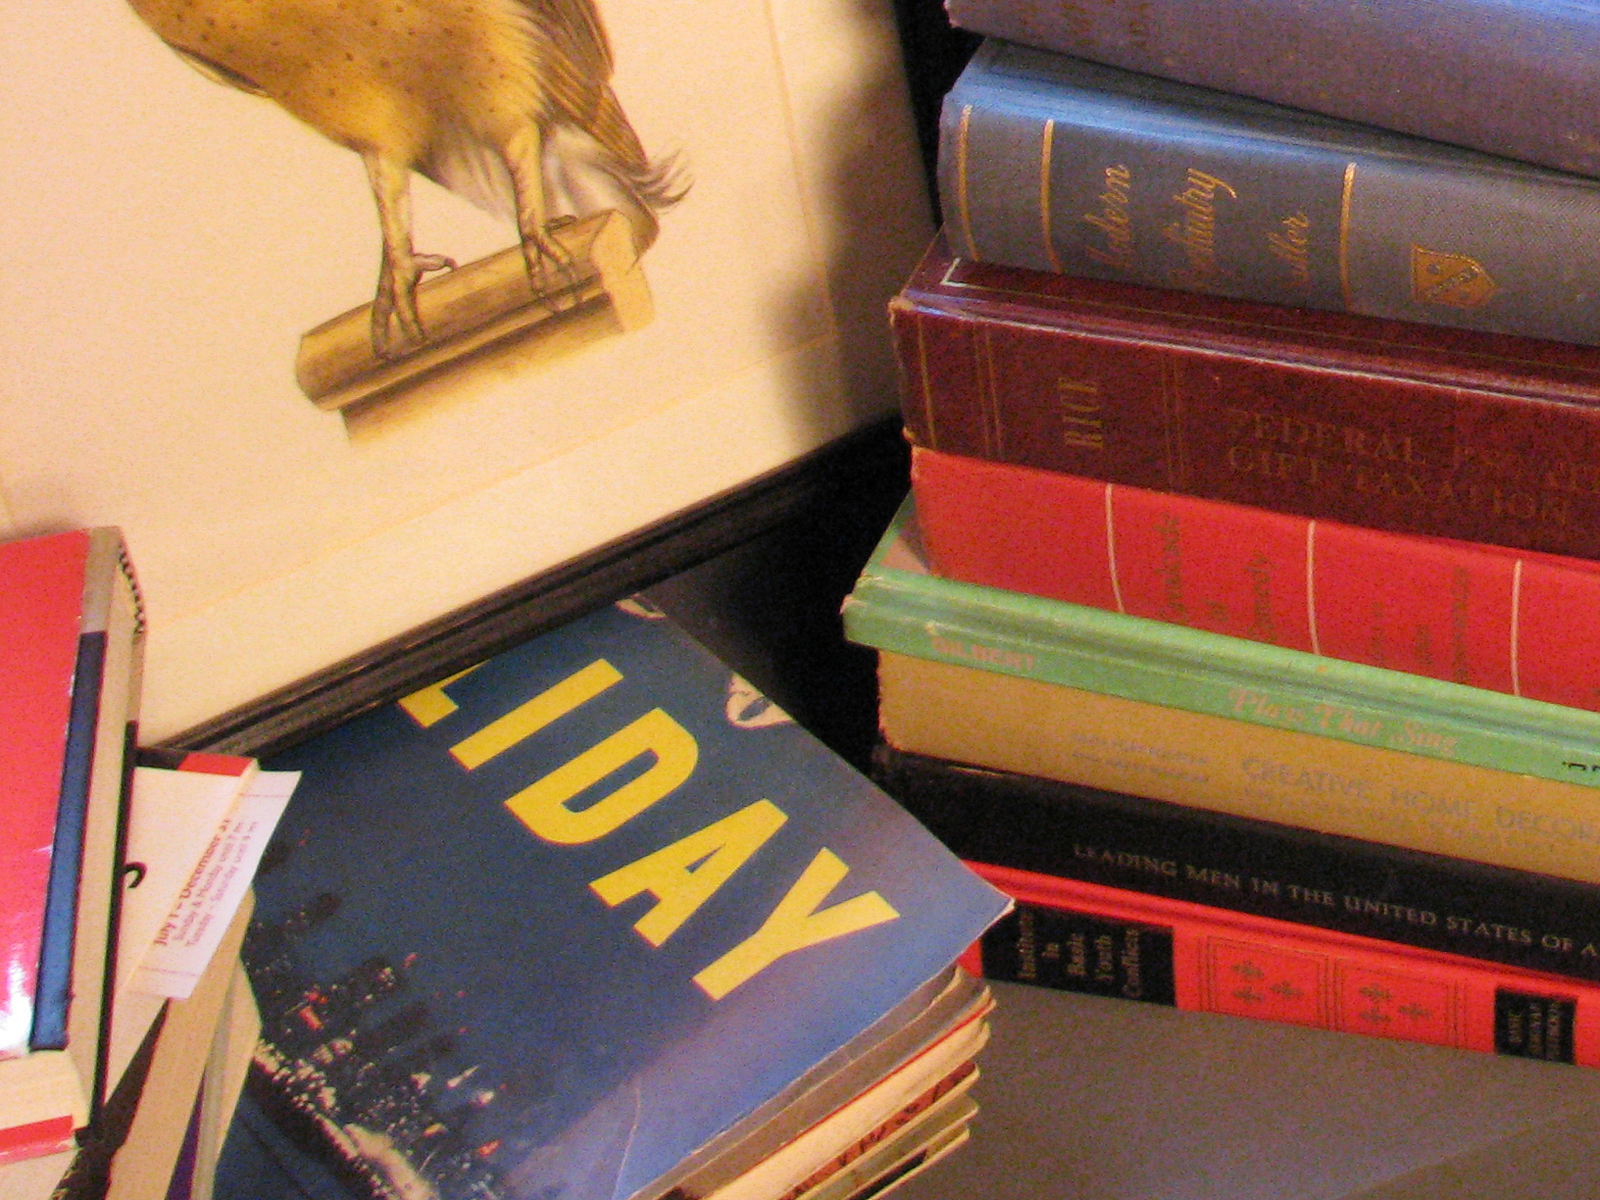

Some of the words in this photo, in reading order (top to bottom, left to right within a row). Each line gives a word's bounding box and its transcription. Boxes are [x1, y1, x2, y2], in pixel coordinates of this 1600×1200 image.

[931, 636, 1036, 669] GILBERT
[1240, 757, 1367, 800] CREATIVE
[1389, 787, 1475, 822] HOME
[153, 921, 175, 947] July
[179, 834, 221, 900] December
[1072, 843, 1178, 876] LEADING
[1185, 864, 1241, 889] MEN
[1250, 877, 1279, 896] IN
[1285, 884, 1335, 907] THE
[1342, 895, 1438, 927] UNITED
[1445, 913, 1532, 944] STATES
[1540, 933, 1574, 952] OF
